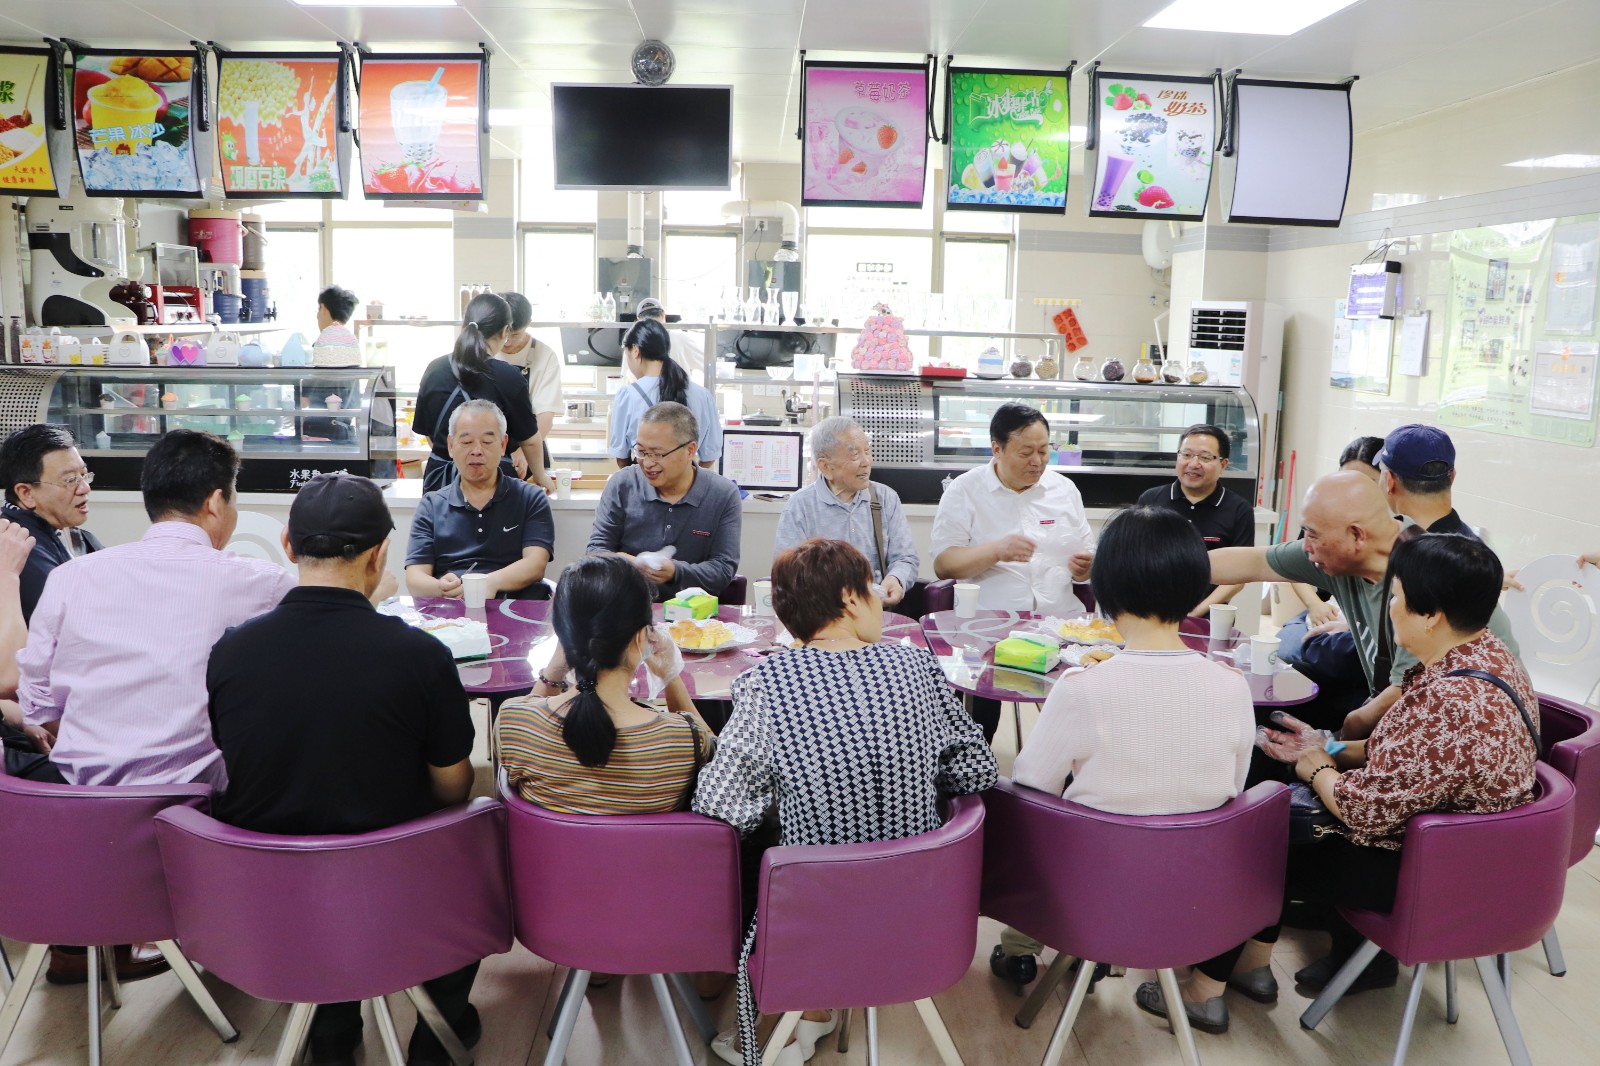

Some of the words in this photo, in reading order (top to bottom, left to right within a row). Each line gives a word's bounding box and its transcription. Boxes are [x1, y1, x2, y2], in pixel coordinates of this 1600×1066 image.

[854, 81, 910, 102] 草莓奶茶
[1157, 90, 1188, 100] 珍珠
[1163, 101, 1208, 117] 奶茶
[229, 166, 287, 190] 现磨豆浆
